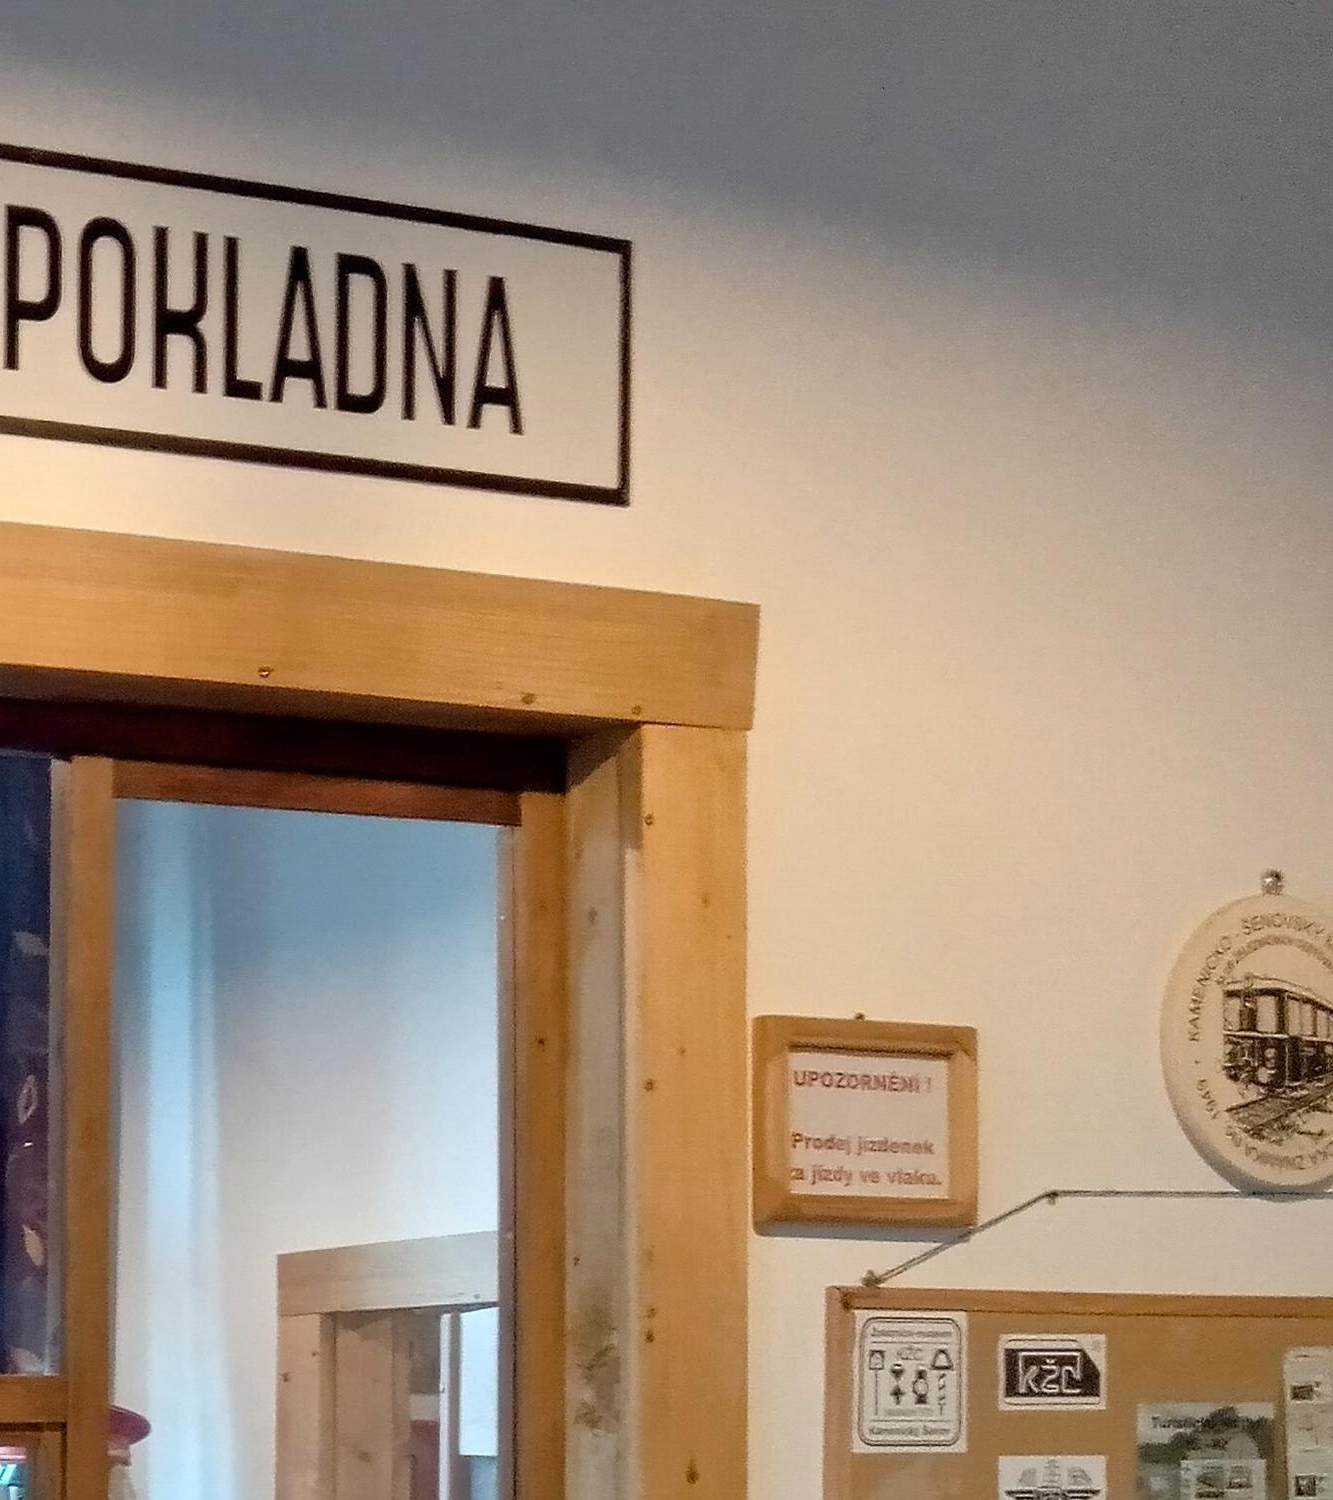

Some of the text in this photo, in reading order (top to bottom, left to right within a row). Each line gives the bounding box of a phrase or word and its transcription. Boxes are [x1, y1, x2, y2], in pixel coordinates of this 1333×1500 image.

[4, 205, 525, 437] POKLADNA
[793, 1069, 921, 1094] UPOZORNĚNÍ
[791, 1132, 851, 1156] Prodej
[811, 1163, 853, 1187] jízdy
[859, 1170, 881, 1184] ve
